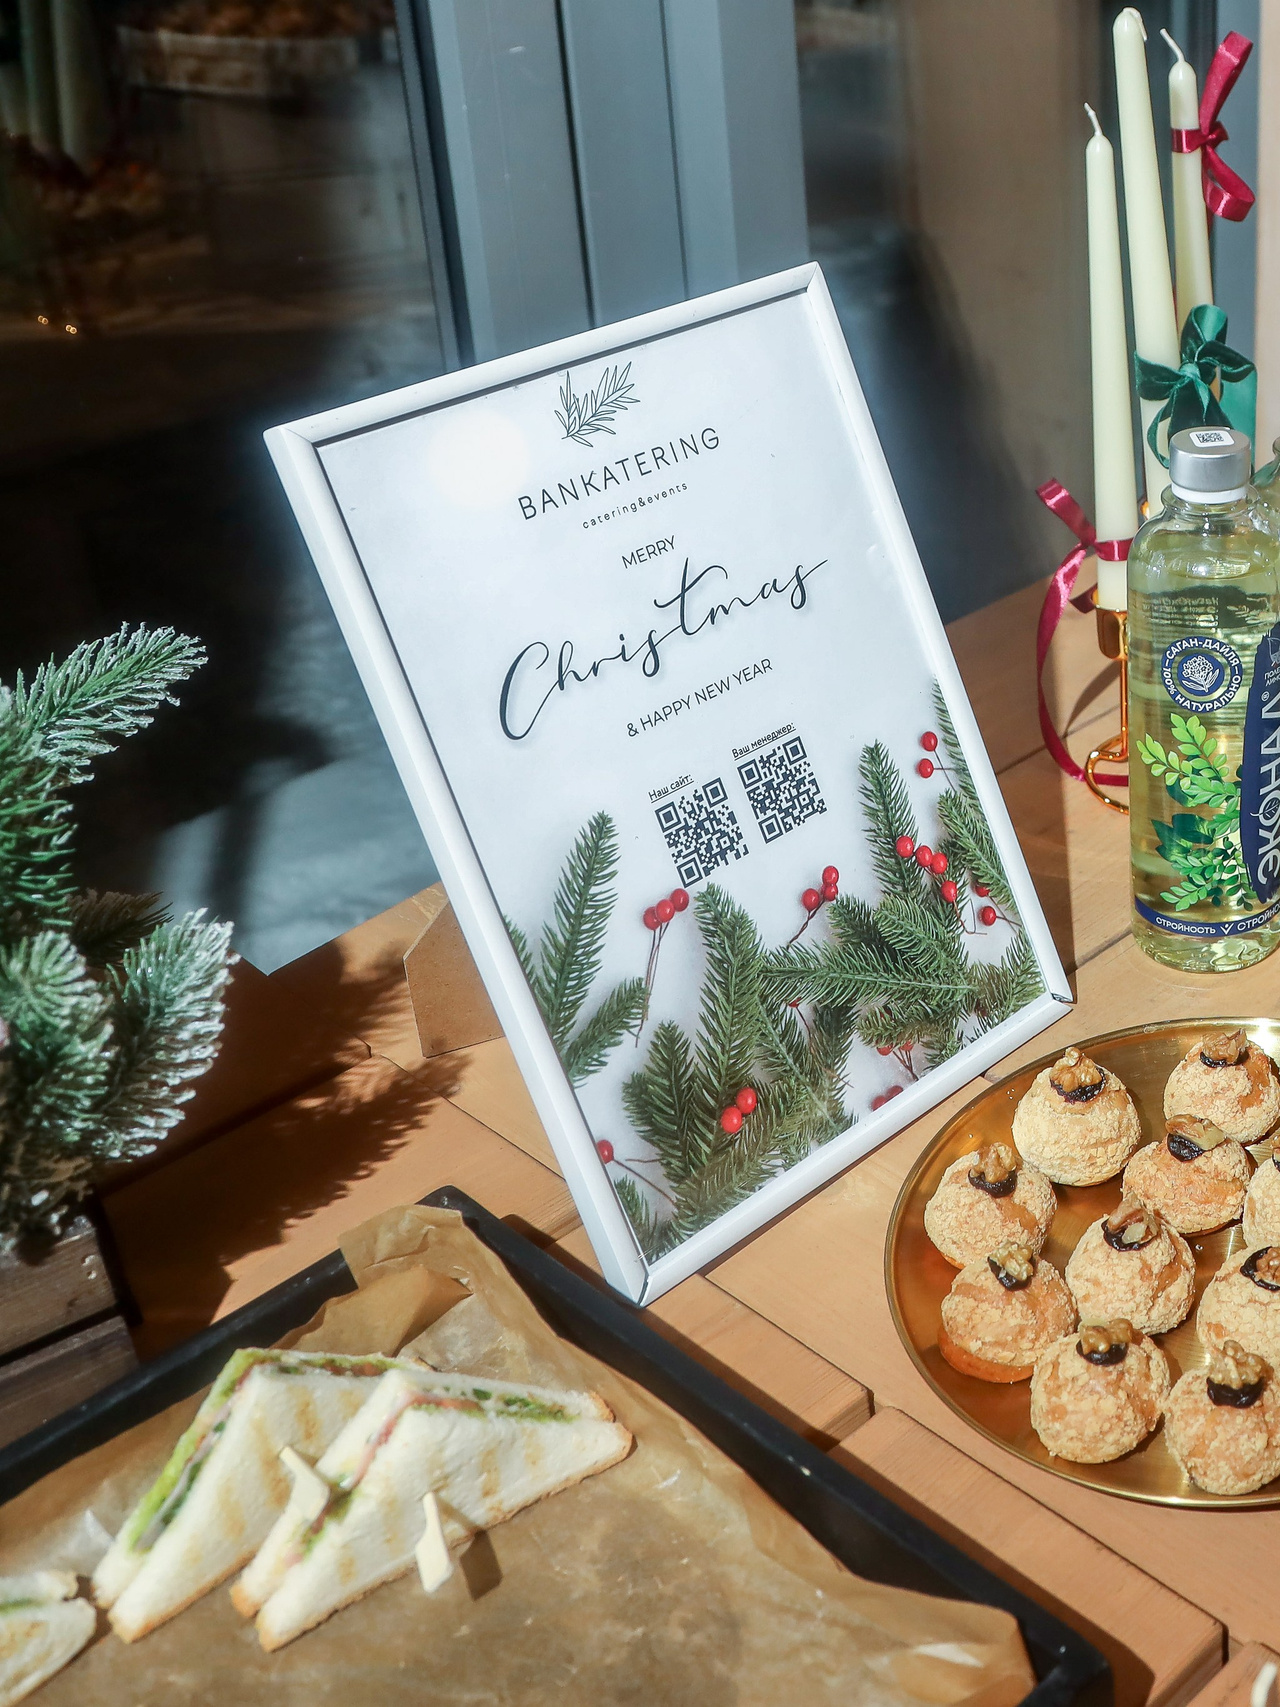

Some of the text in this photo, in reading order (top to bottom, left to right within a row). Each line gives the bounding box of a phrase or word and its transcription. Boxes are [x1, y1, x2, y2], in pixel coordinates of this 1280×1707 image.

[517, 427, 721, 521] BANKATERING
[582, 482, 689, 529] catering&events
[621, 535, 676, 569] MERRY
[499, 557, 828, 741] Christmas
[626, 658, 773, 738] & HAPPY NEW YEAR
[1162, 668, 1241, 712] 100% НАТУРАЛЬНО
[731, 722, 795, 759] Ваш менеджер:
[648, 774, 693, 801] Наш сайт:
[1155, 916, 1216, 934] СТРОЙНОСТЬ
